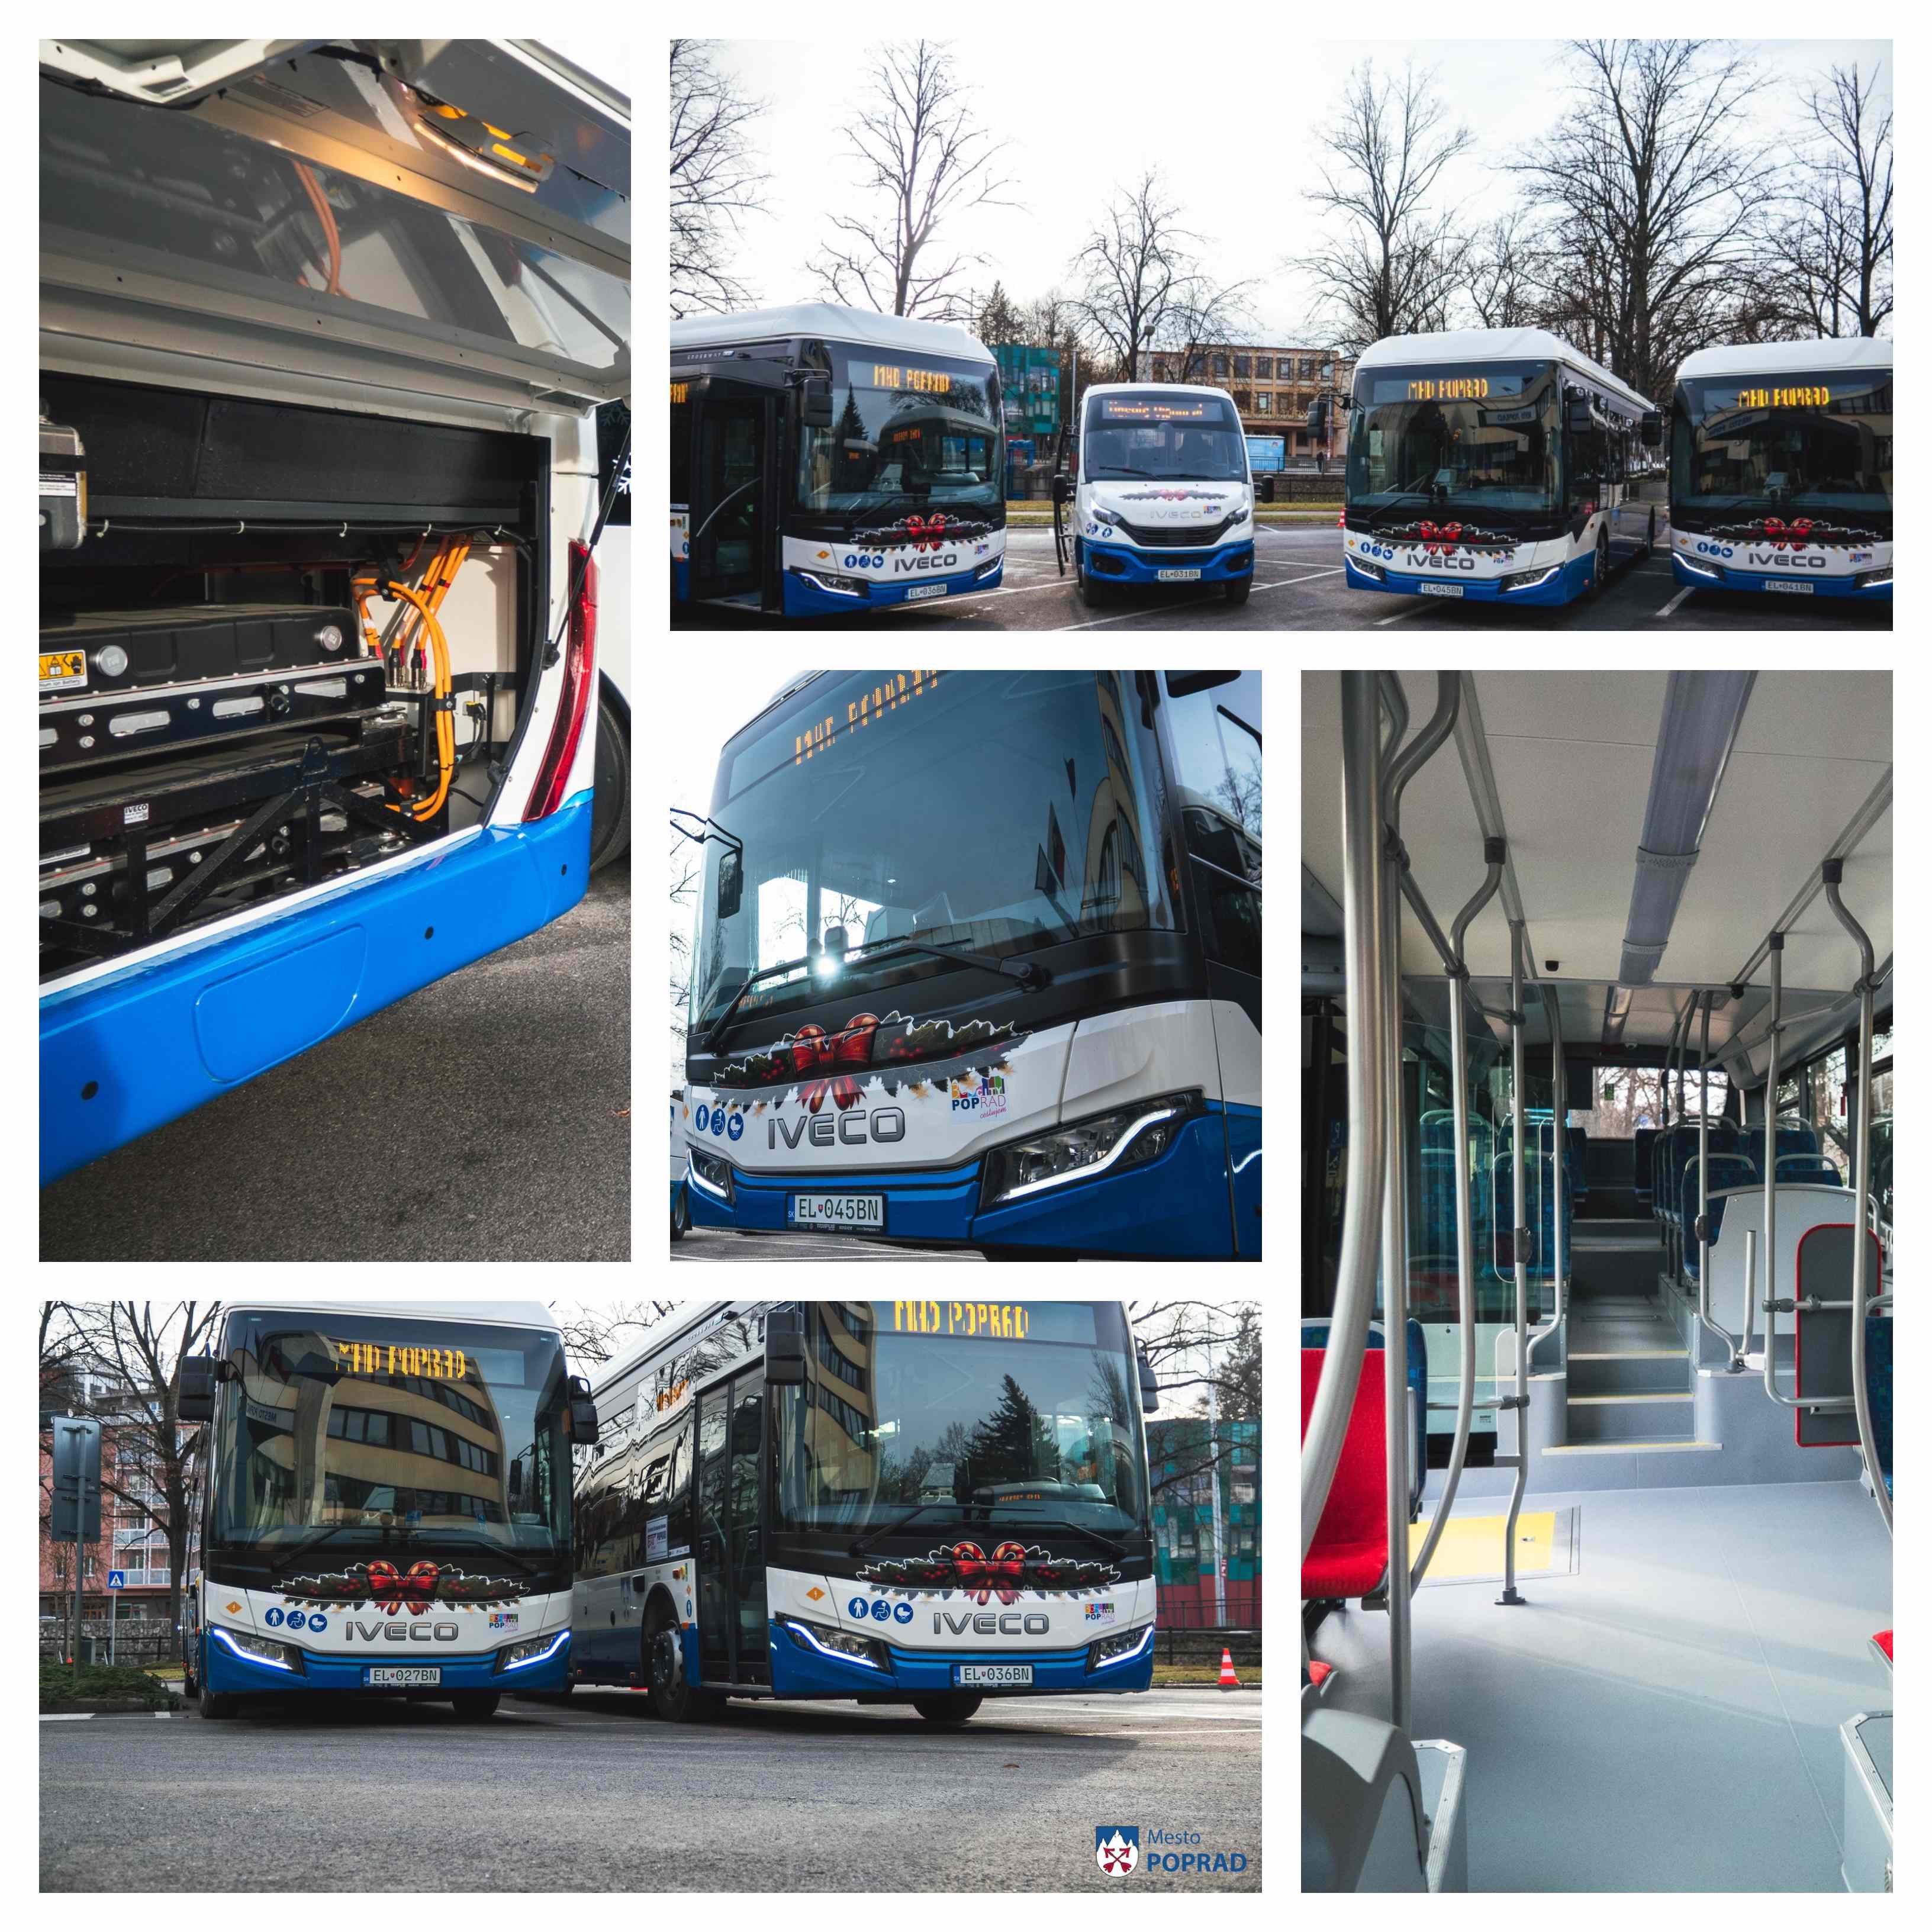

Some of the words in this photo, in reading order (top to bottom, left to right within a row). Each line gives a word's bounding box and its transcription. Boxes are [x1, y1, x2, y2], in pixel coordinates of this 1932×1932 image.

[894, 554, 957, 572] IVECO
[1407, 553, 1475, 570] IVECO
[1749, 553, 1827, 568] IVECO
[125, 804, 147, 814] IVECO
[952, 1095, 1006, 1111] POPRAD
[768, 1106, 906, 1150] IVECO
[346, 1621, 459, 1641] IVECO
[933, 1612, 1049, 1635] IVECO
